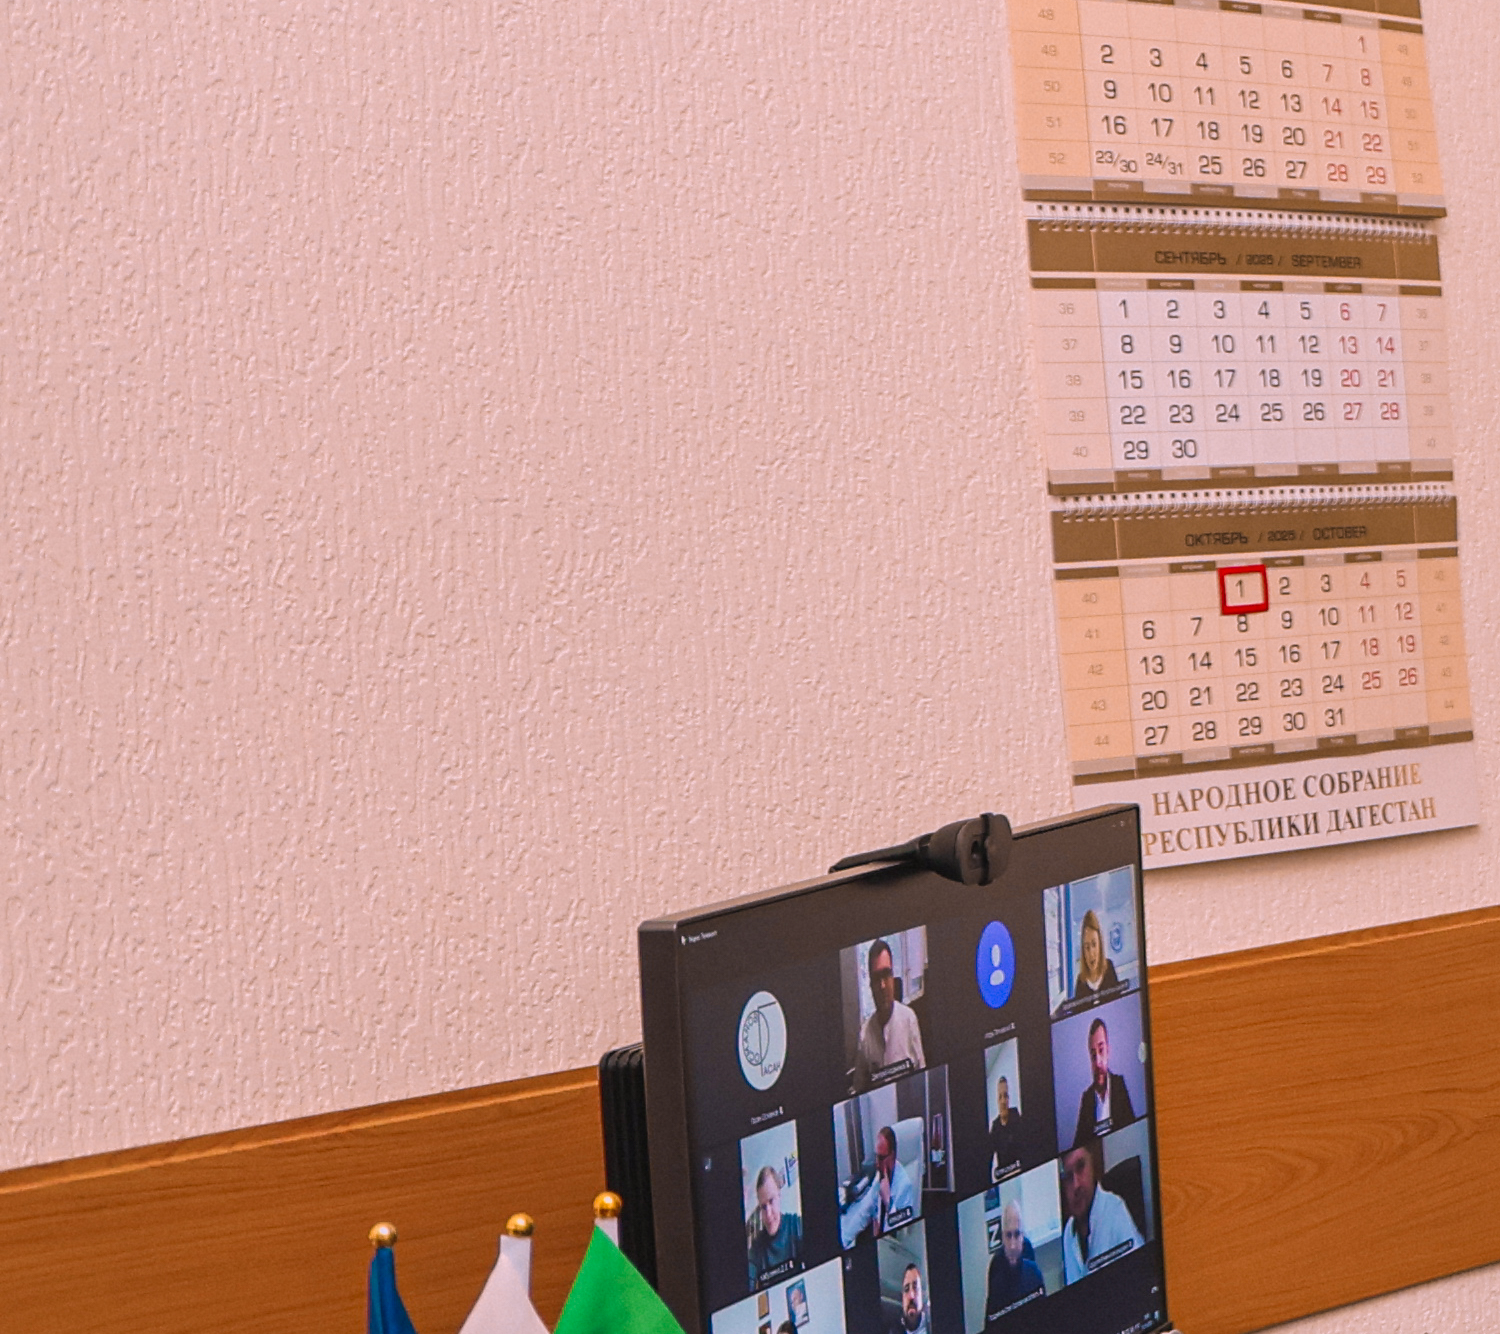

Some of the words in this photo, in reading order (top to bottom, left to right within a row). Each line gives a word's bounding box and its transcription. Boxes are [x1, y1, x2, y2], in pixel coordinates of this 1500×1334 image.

[1358, 36, 1366, 53] 1
[1101, 44, 1114, 64] 2
[1150, 48, 1162, 67] 3
[1196, 53, 1208, 70] 4
[1240, 56, 1251, 75] 5
[1282, 60, 1293, 78] 6
[1323, 64, 1333, 82] 7
[1361, 68, 1371, 86] 8
[1104, 80, 1117, 99] 9
[1148, 83, 1172, 103] 10
[1194, 86, 1214, 105] 11
[1239, 90, 1260, 109] 12
[1281, 94, 1302, 113] 13
[1322, 97, 1342, 115] 14
[1361, 101, 1379, 120] 15
[1102, 115, 1127, 135] 16
[1151, 118, 1174, 137] 17
[1198, 121, 1220, 140] 18
[1242, 124, 1263, 143] 19
[1283, 127, 1305, 146] 20
[1324, 130, 1343, 148] 21
[1362, 133, 1382, 152] 22
[1199, 155, 1222, 175] 25
[1243, 158, 1265, 177] 26
[1286, 160, 1307, 179] 27
[1327, 163, 1348, 182] 28
[1366, 166, 1387, 185] 29
[1155, 250, 1227, 266] СЕНТЯБРЬ
[1291, 254, 1362, 269] SEPTEMBER
[1119, 299, 1128, 318] 1
[1167, 300, 1179, 319] 2
[1214, 300, 1225, 319] 3
[1258, 301, 1270, 318] 4
[1300, 302, 1311, 320] 5
[1340, 303, 1350, 321] 6
[1377, 303, 1387, 321] 7
[1121, 335, 1134, 354] 8
[1170, 335, 1182, 354] 9
[1212, 335, 1235, 353] 10
[1256, 335, 1275, 353] 11
[1299, 335, 1319, 354] 12
[1340, 336, 1358, 354] 13
[1377, 337, 1395, 353] 14
[1119, 370, 1143, 389] 15
[1168, 369, 1191, 388] 16
[1215, 369, 1236, 387] 17
[1260, 369, 1280, 388] 18
[1302, 369, 1322, 387] 19
[1341, 369, 1361, 387] 20
[1378, 369, 1395, 387] 21
[1120, 405, 1146, 425] 22
[1169, 404, 1194, 424] 23
[1216, 404, 1240, 422] 24
[1261, 403, 1283, 422] 25
[1303, 402, 1325, 421] 26
[1344, 402, 1363, 421] 27
[1381, 402, 1400, 420] 28
[1124, 440, 1149, 460] 29
[1172, 439, 1197, 459] 30
[1185, 532, 1248, 547] ОКТЯБРЬ
[1313, 526, 1367, 541] OCTOBER
[1236, 579, 1244, 597] 1
[1279, 577, 1290, 595] 2
[1321, 574, 1331, 593] 3
[1360, 572, 1371, 588] 4
[1397, 569, 1406, 588] 5
[1143, 620, 1155, 640] 6
[1191, 617, 1203, 636] 7
[1237, 614, 1249, 633] 8
[1282, 611, 1293, 629] 9
[1319, 607, 1339, 626] 10
[1359, 605, 1375, 623] 11
[1396, 602, 1413, 620] 12
[1141, 655, 1164, 674] 13
[1189, 652, 1212, 670] 14
[1235, 648, 1257, 667] 15
[1280, 644, 1301, 663] 16
[1322, 641, 1341, 659] 17
[1362, 638, 1379, 656] 18
[1398, 635, 1416, 653] 19
[1142, 690, 1168, 711] 20
[1190, 686, 1211, 706] 21
[1236, 682, 1259, 702] 22
[1281, 678, 1303, 698] 23
[1323, 675, 1344, 694] 24
[1362, 671, 1381, 690] 25
[1399, 667, 1418, 686] 26
[1145, 725, 1169, 746] 27
[1192, 721, 1217, 741] 28
[1239, 716, 1262, 736] 29
[1283, 712, 1306, 732] 30
[1325, 708, 1344, 727] 31
[1152, 776, 1294, 818] НАРОДНОЕ
[1303, 763, 1423, 798] СОБРАНИЕ
[1143, 808, 1321, 857] РЕСПУБЛИКИ
[1326, 797, 1437, 835] ДАГЕСТАН
